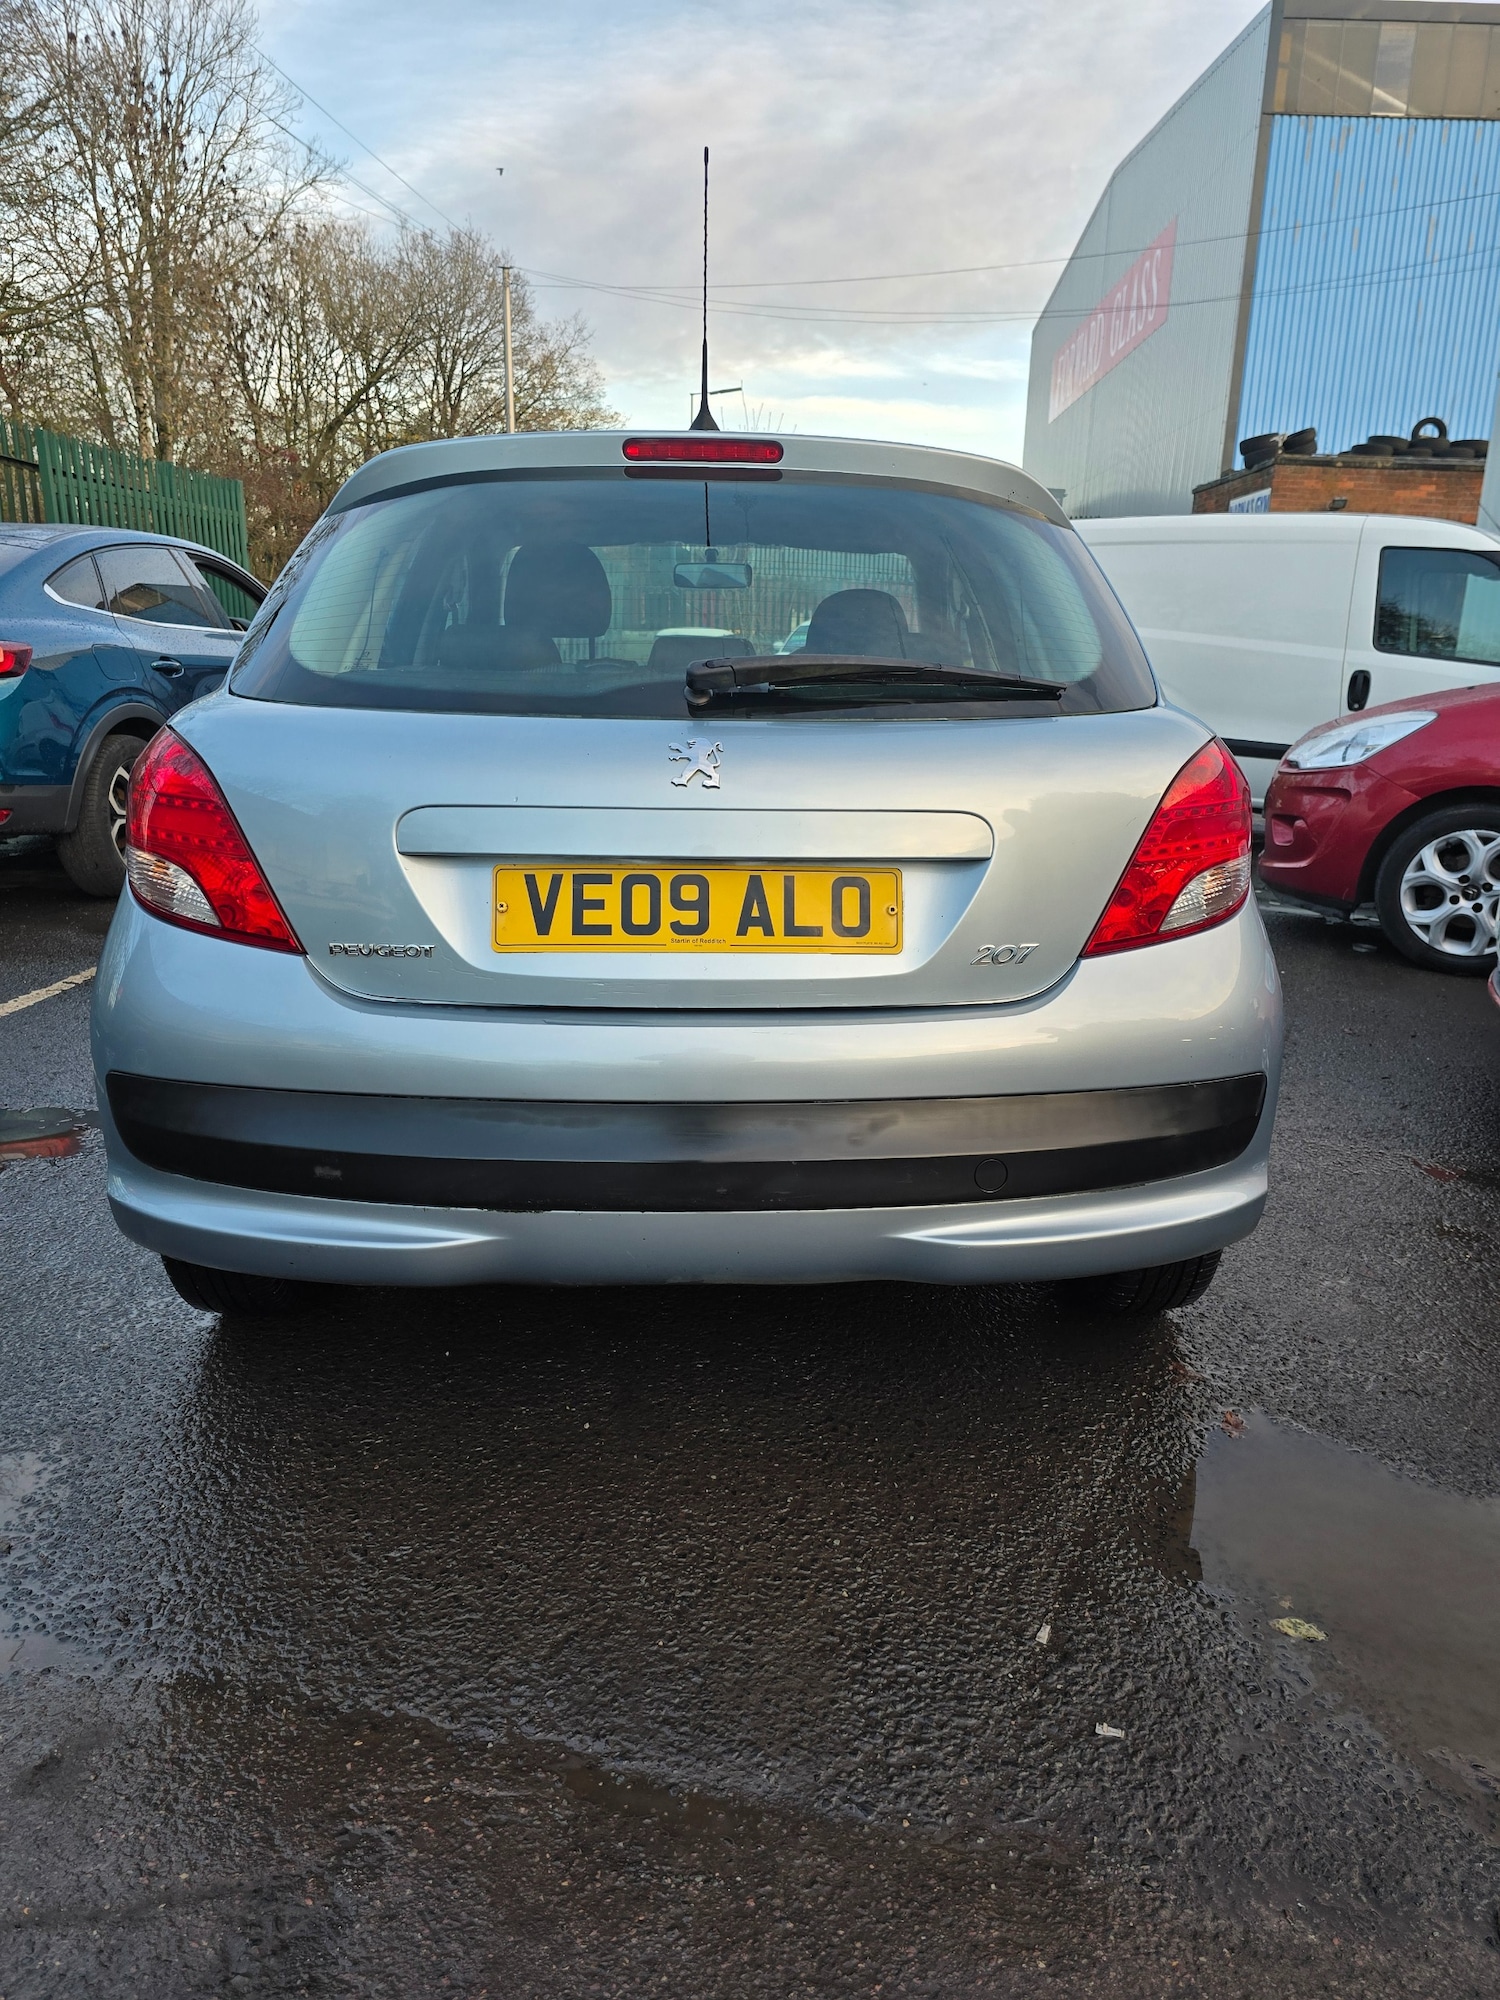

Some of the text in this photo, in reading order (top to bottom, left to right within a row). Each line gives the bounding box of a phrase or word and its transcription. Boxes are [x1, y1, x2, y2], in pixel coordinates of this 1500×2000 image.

[1109, 247, 1162, 357] GLASS
[523, 873, 872, 938] VE09 ALO
[328, 941, 436, 958] PEUGEOT
[970, 943, 1041, 966] 207
